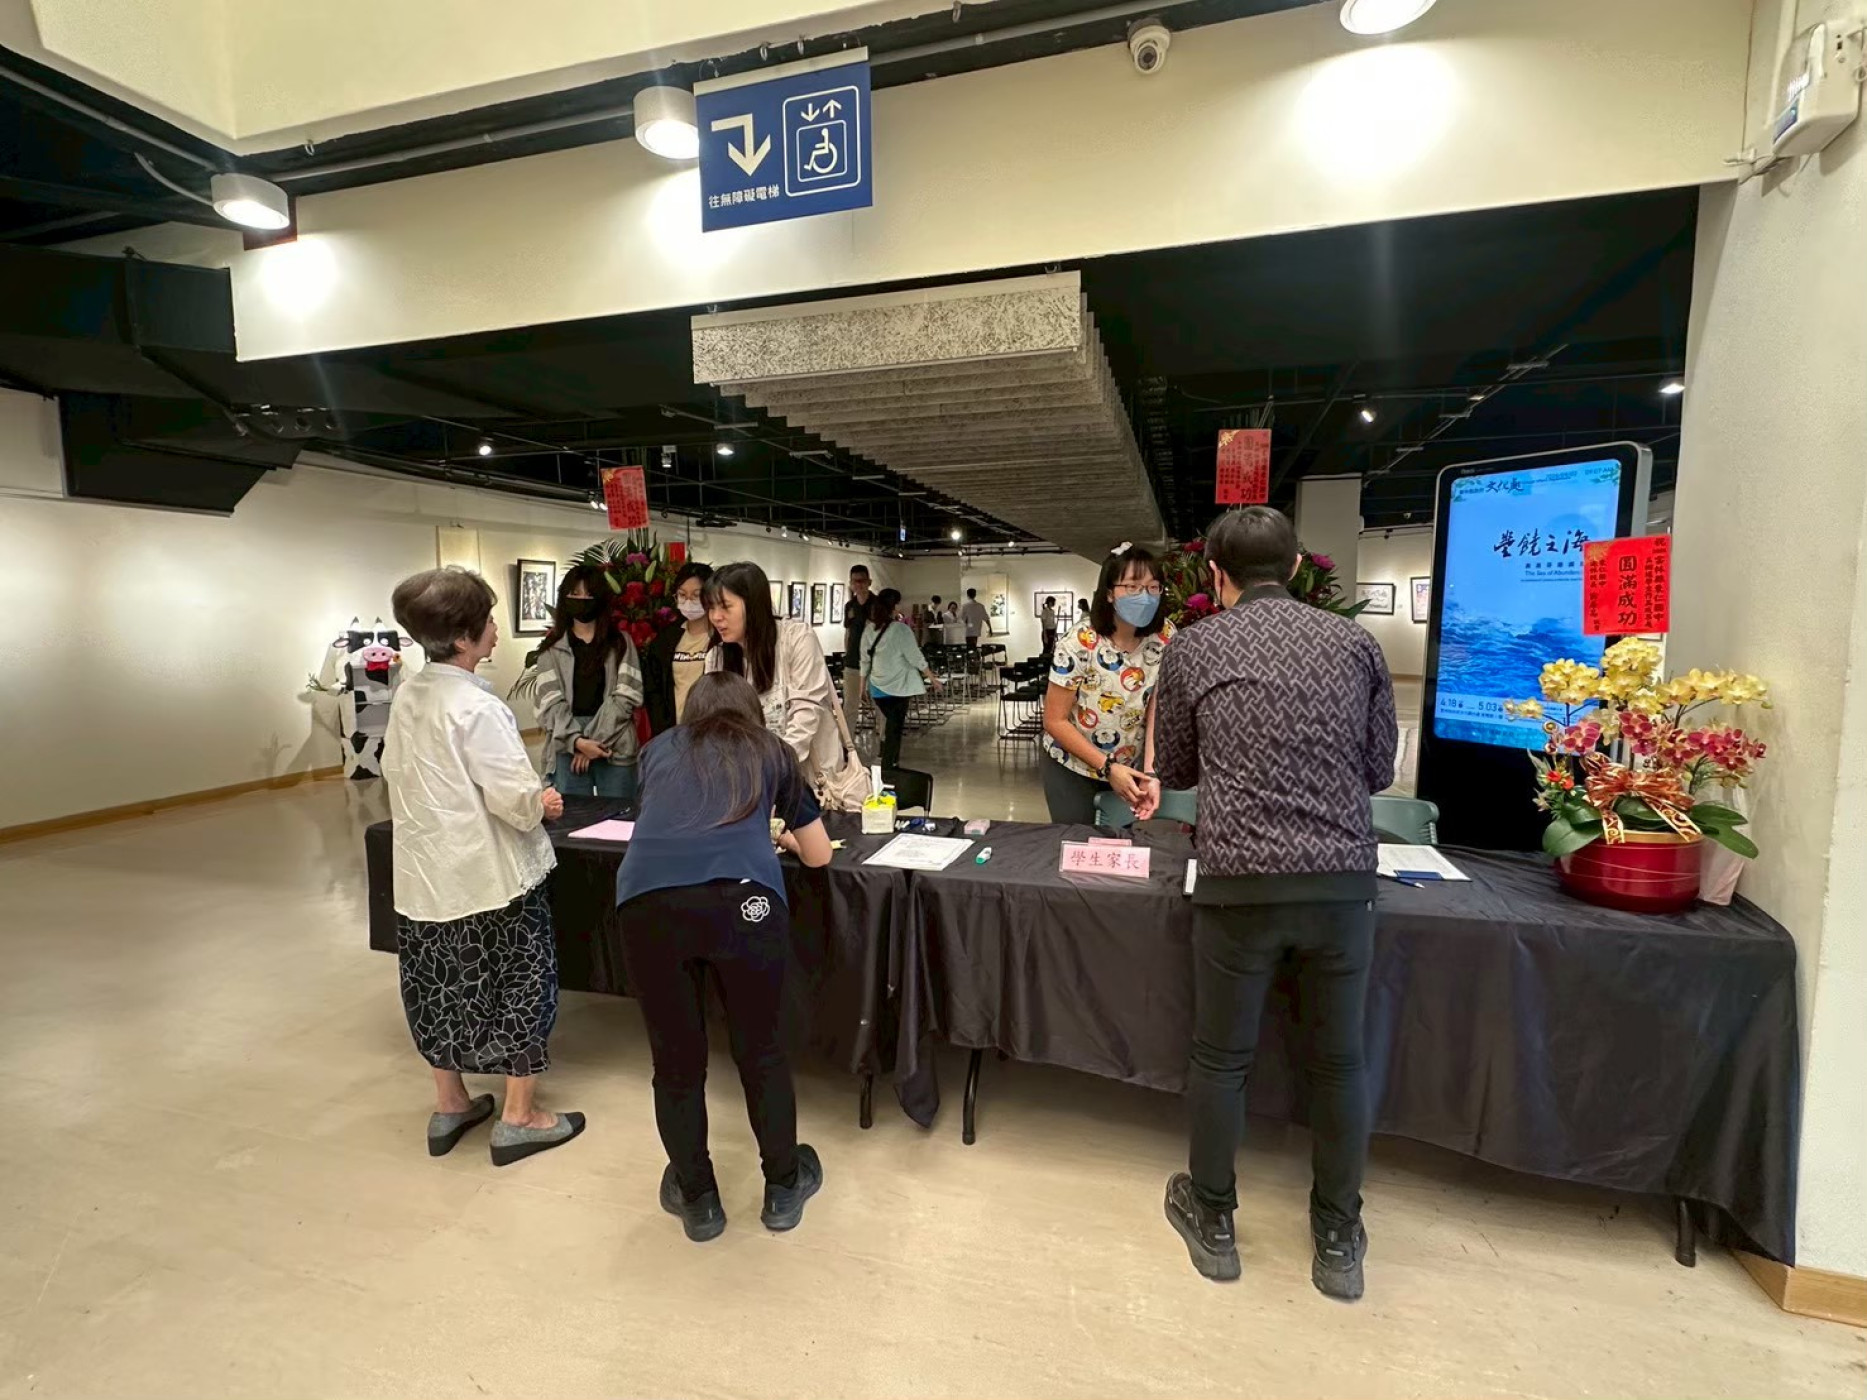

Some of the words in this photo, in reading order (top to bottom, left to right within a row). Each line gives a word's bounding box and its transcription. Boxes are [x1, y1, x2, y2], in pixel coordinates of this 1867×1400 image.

[708, 184, 780, 209] 往無障礙電梯
[1618, 555, 1638, 626] 圓滿成功
[1070, 850, 1140, 870] 學生家長
